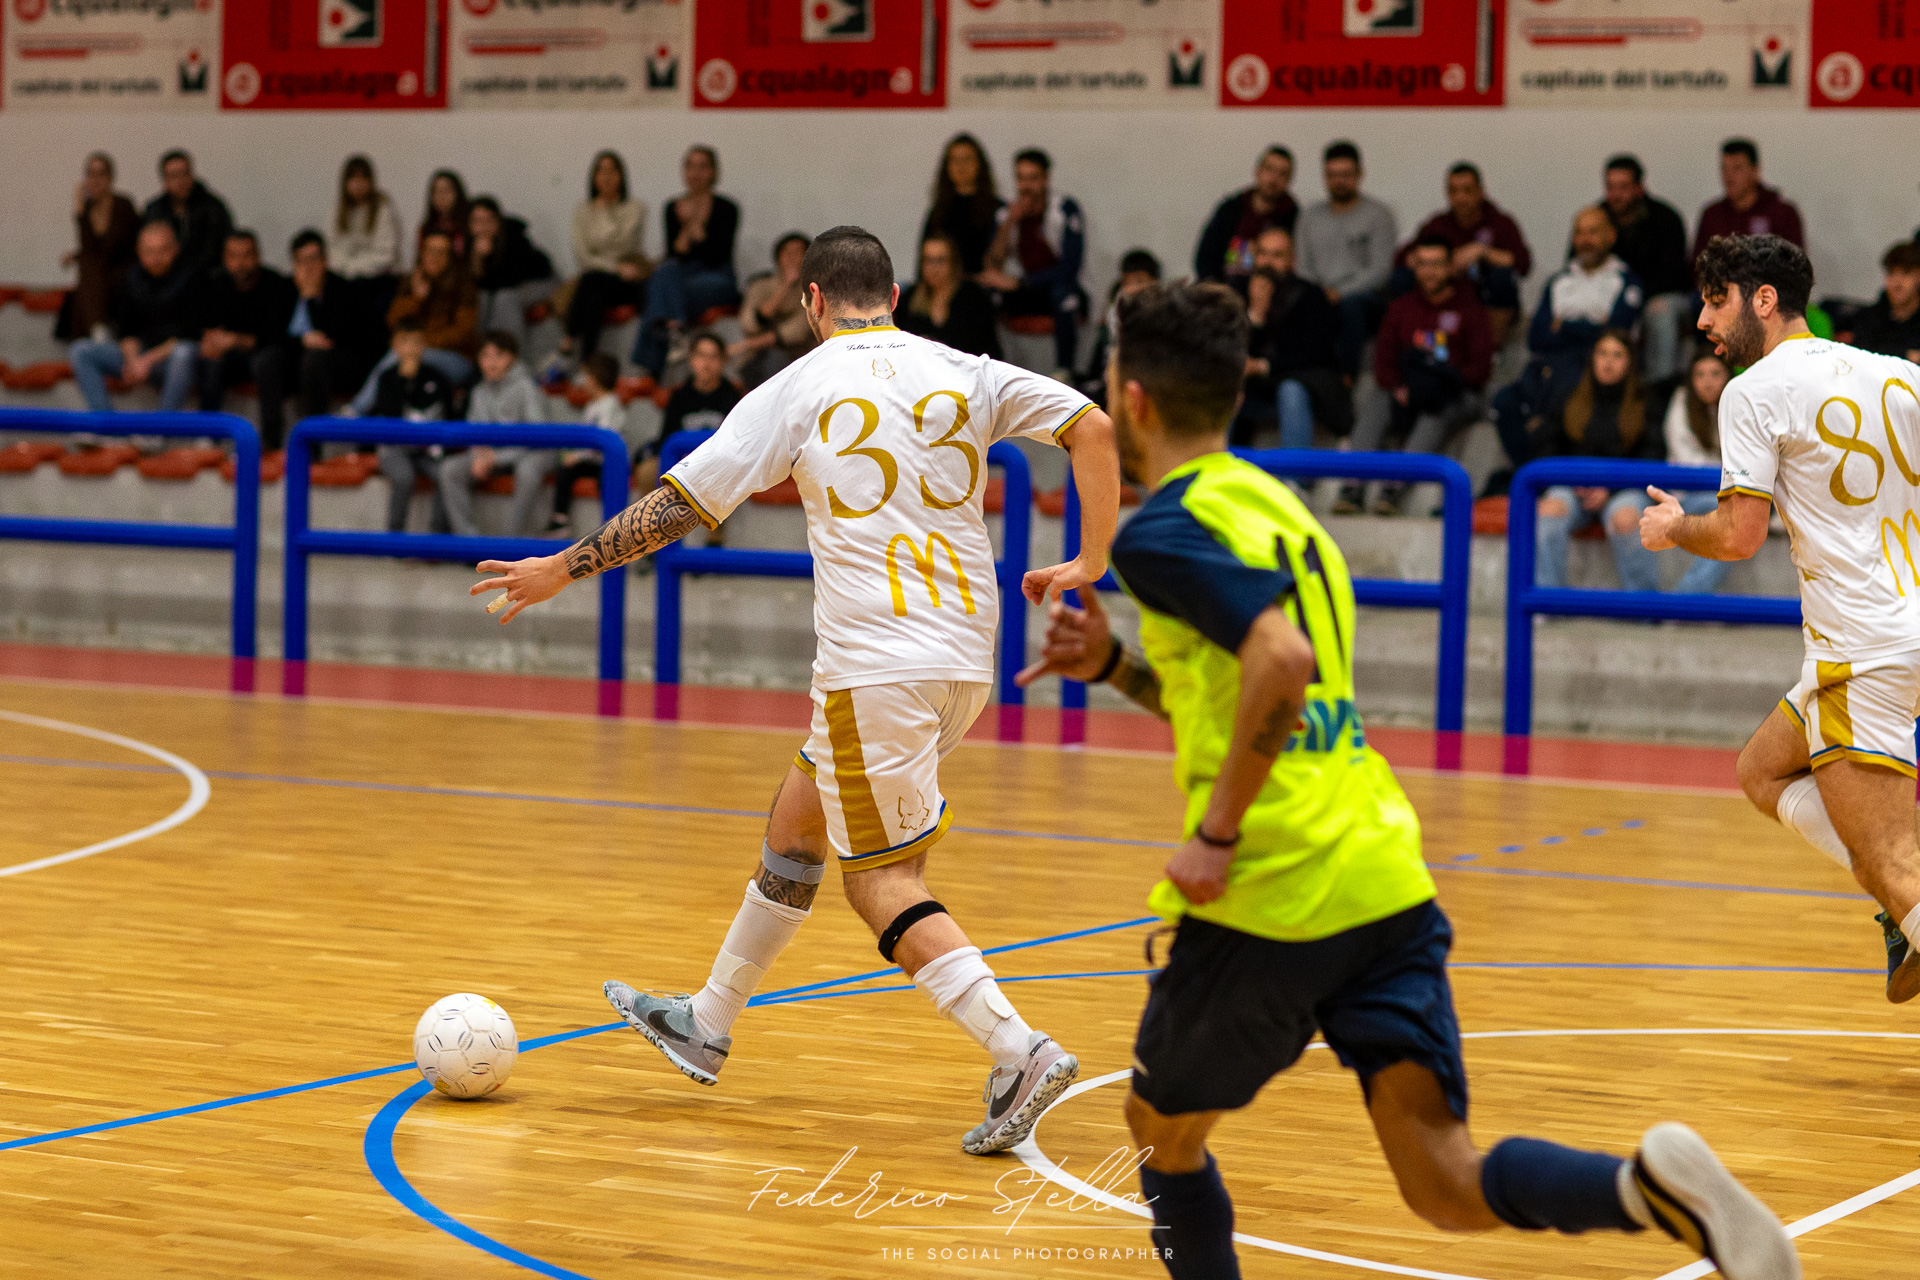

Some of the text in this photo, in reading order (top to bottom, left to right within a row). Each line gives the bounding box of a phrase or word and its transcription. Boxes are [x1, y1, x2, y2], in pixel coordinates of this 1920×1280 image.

[1226, 53, 1467, 102] acqualagna
[1816, 51, 1920, 101] acq
[817, 390, 981, 519] 33
